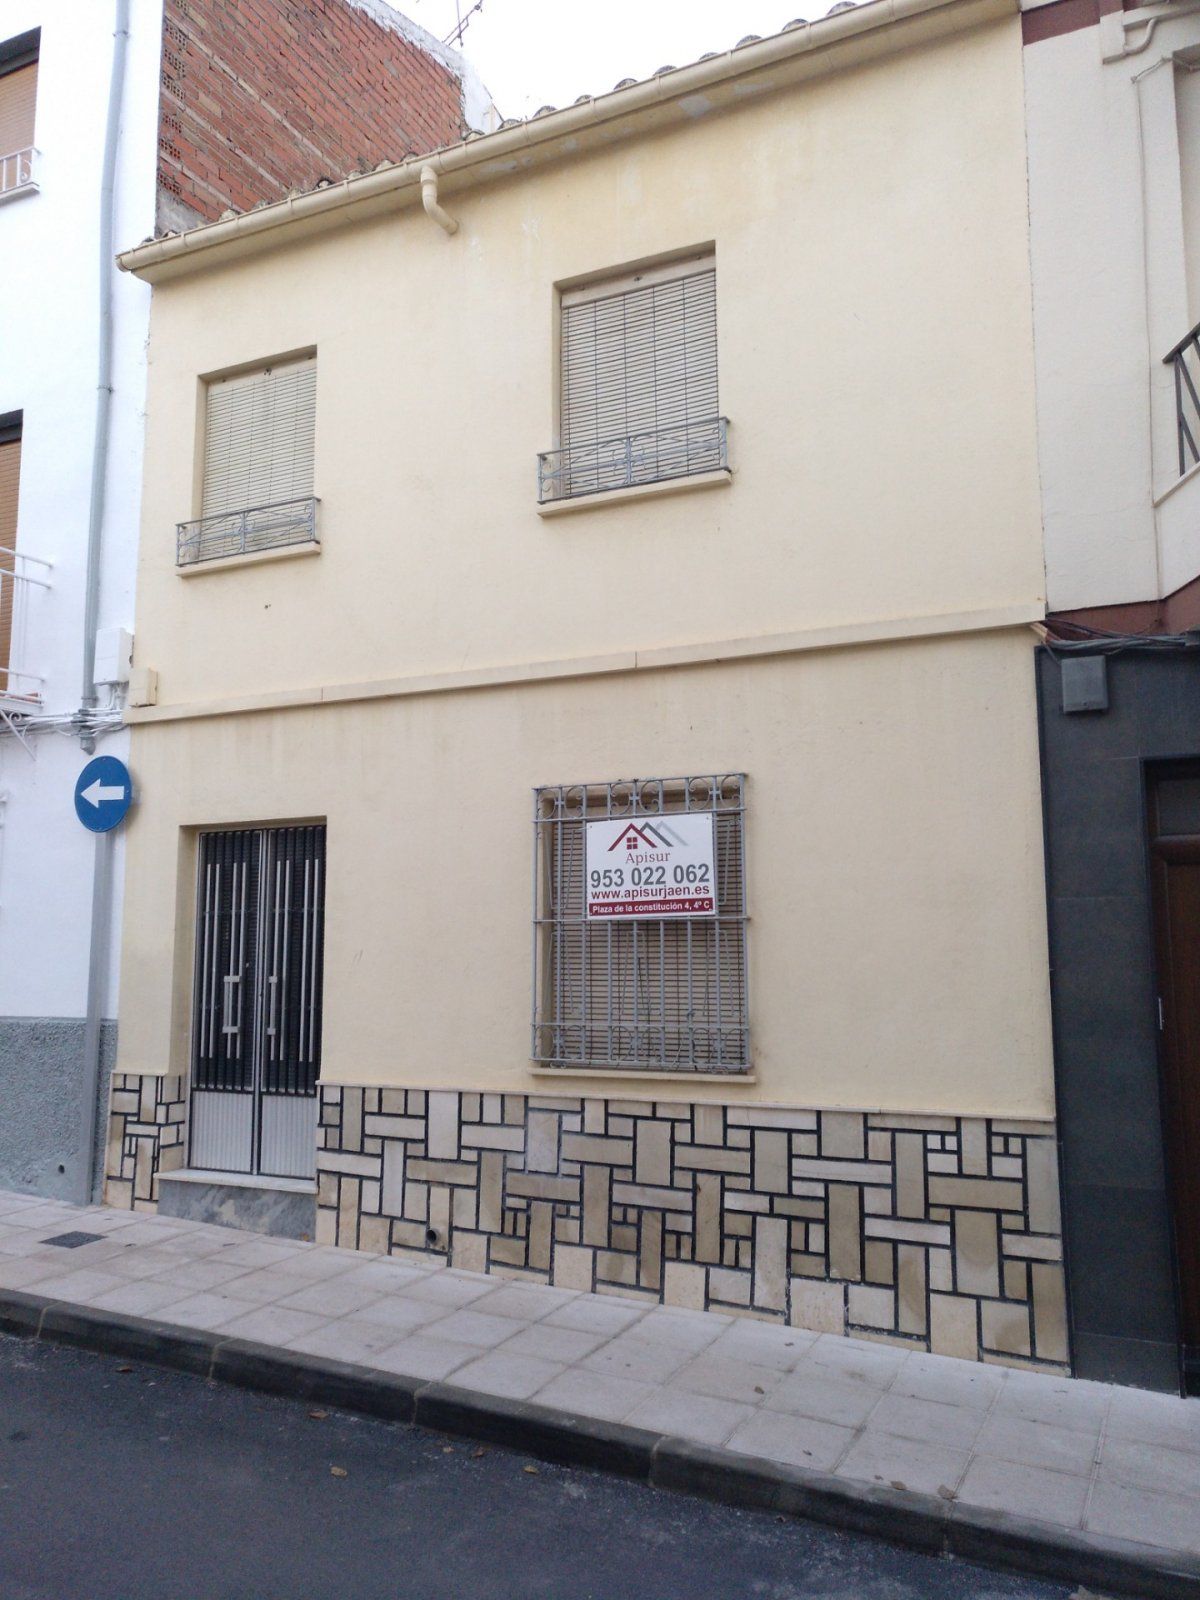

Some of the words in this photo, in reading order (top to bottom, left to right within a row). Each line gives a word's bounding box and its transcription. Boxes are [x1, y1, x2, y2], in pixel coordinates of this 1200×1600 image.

[625, 851, 671, 866] Apisur
[591, 868, 624, 888] 953
[631, 866, 666, 886] 022
[673, 863, 710, 884] 062
[591, 884, 710, 900] www.apisurjaen.es
[592, 905, 613, 913] Plaza
[614, 904, 624, 912] de
[625, 904, 633, 912] la
[634, 902, 683, 911] constitución
[684, 902, 692, 910] 4,
[703, 900, 710, 908] C
